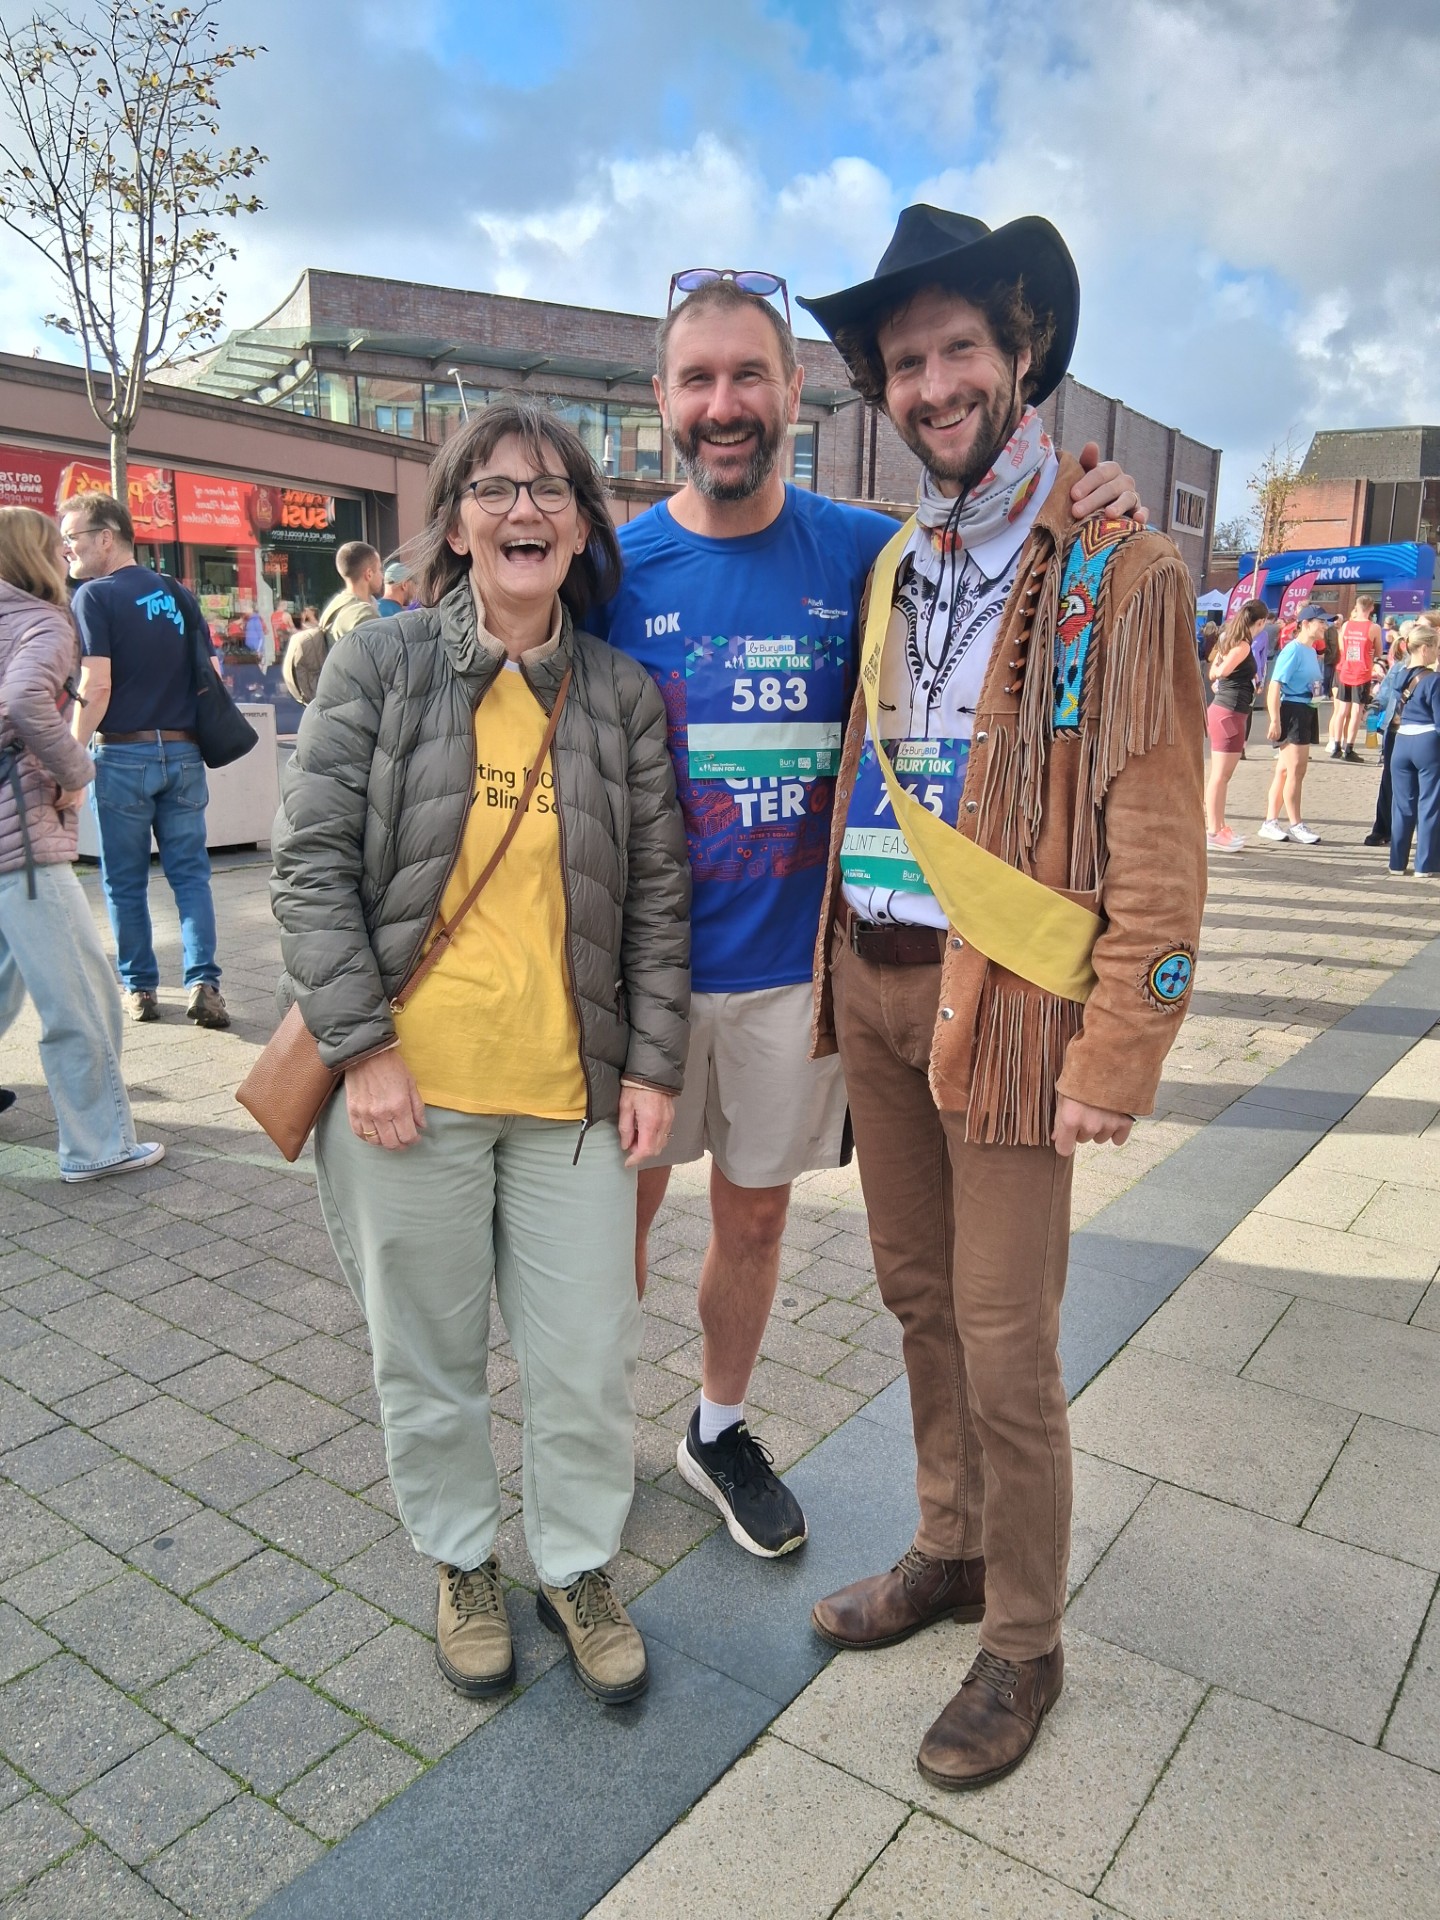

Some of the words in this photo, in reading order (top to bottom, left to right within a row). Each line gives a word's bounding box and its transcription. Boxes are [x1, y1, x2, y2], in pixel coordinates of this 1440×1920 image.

[1316, 556, 1347, 566] BuryBID
[1338, 566, 1360, 579] 10K
[1288, 588, 1308, 597] SUB
[645, 612, 681, 638] 10K
[760, 644, 793, 653] BuryBID
[748, 656, 782, 668] BURY
[785, 656, 810, 668] 10K
[731, 677, 808, 712] 583
[909, 746, 937, 756] BuryBID
[780, 759, 795, 768] Bury
[896, 759, 926, 772] BURY
[928, 760, 952, 773] 10K
[487, 786, 529, 812] Blin
[734, 783, 806, 827] TER
[844, 834, 876, 851] CLINT
[903, 870, 920, 882] Bury
